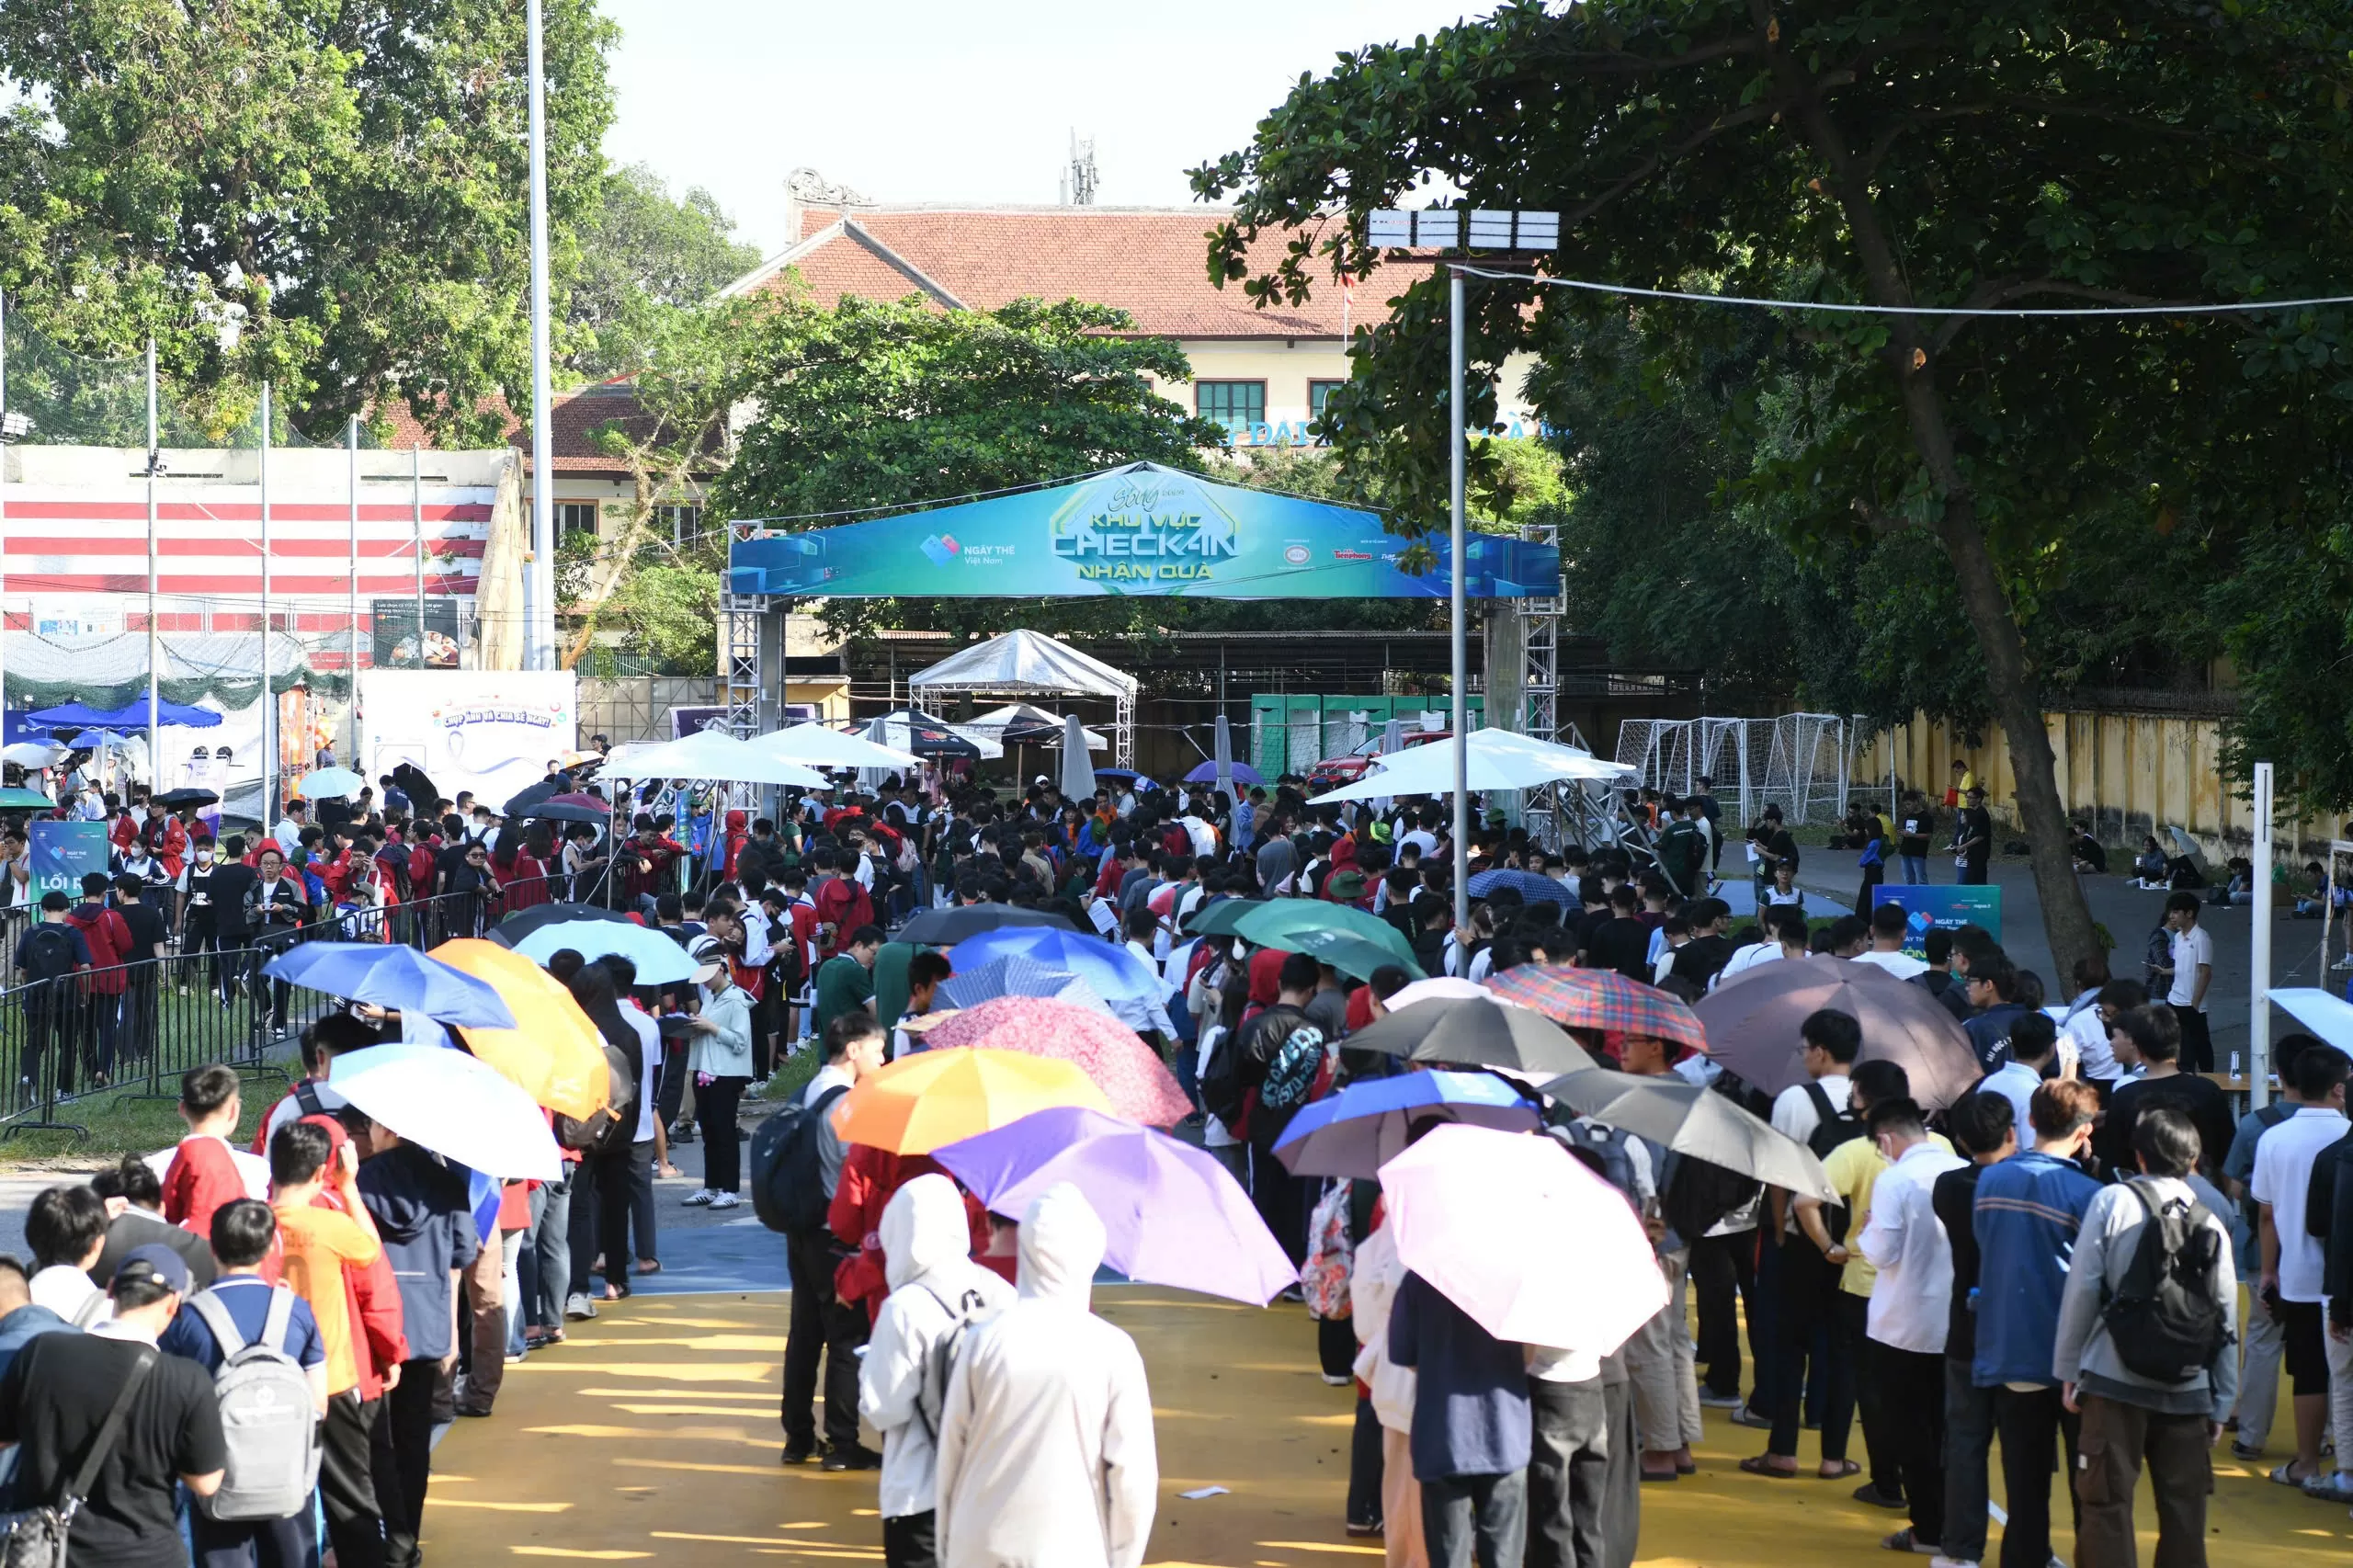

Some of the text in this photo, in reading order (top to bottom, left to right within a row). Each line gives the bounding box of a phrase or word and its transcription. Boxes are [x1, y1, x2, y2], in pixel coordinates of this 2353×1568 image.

[1088, 512, 1203, 530] KHU VỰC
[983, 557, 1003, 565] Nam
[1076, 562, 1214, 581] NHẬN QUÀ
[495, 710, 516, 723] CHIA
[40, 871, 68, 890] LỐI
